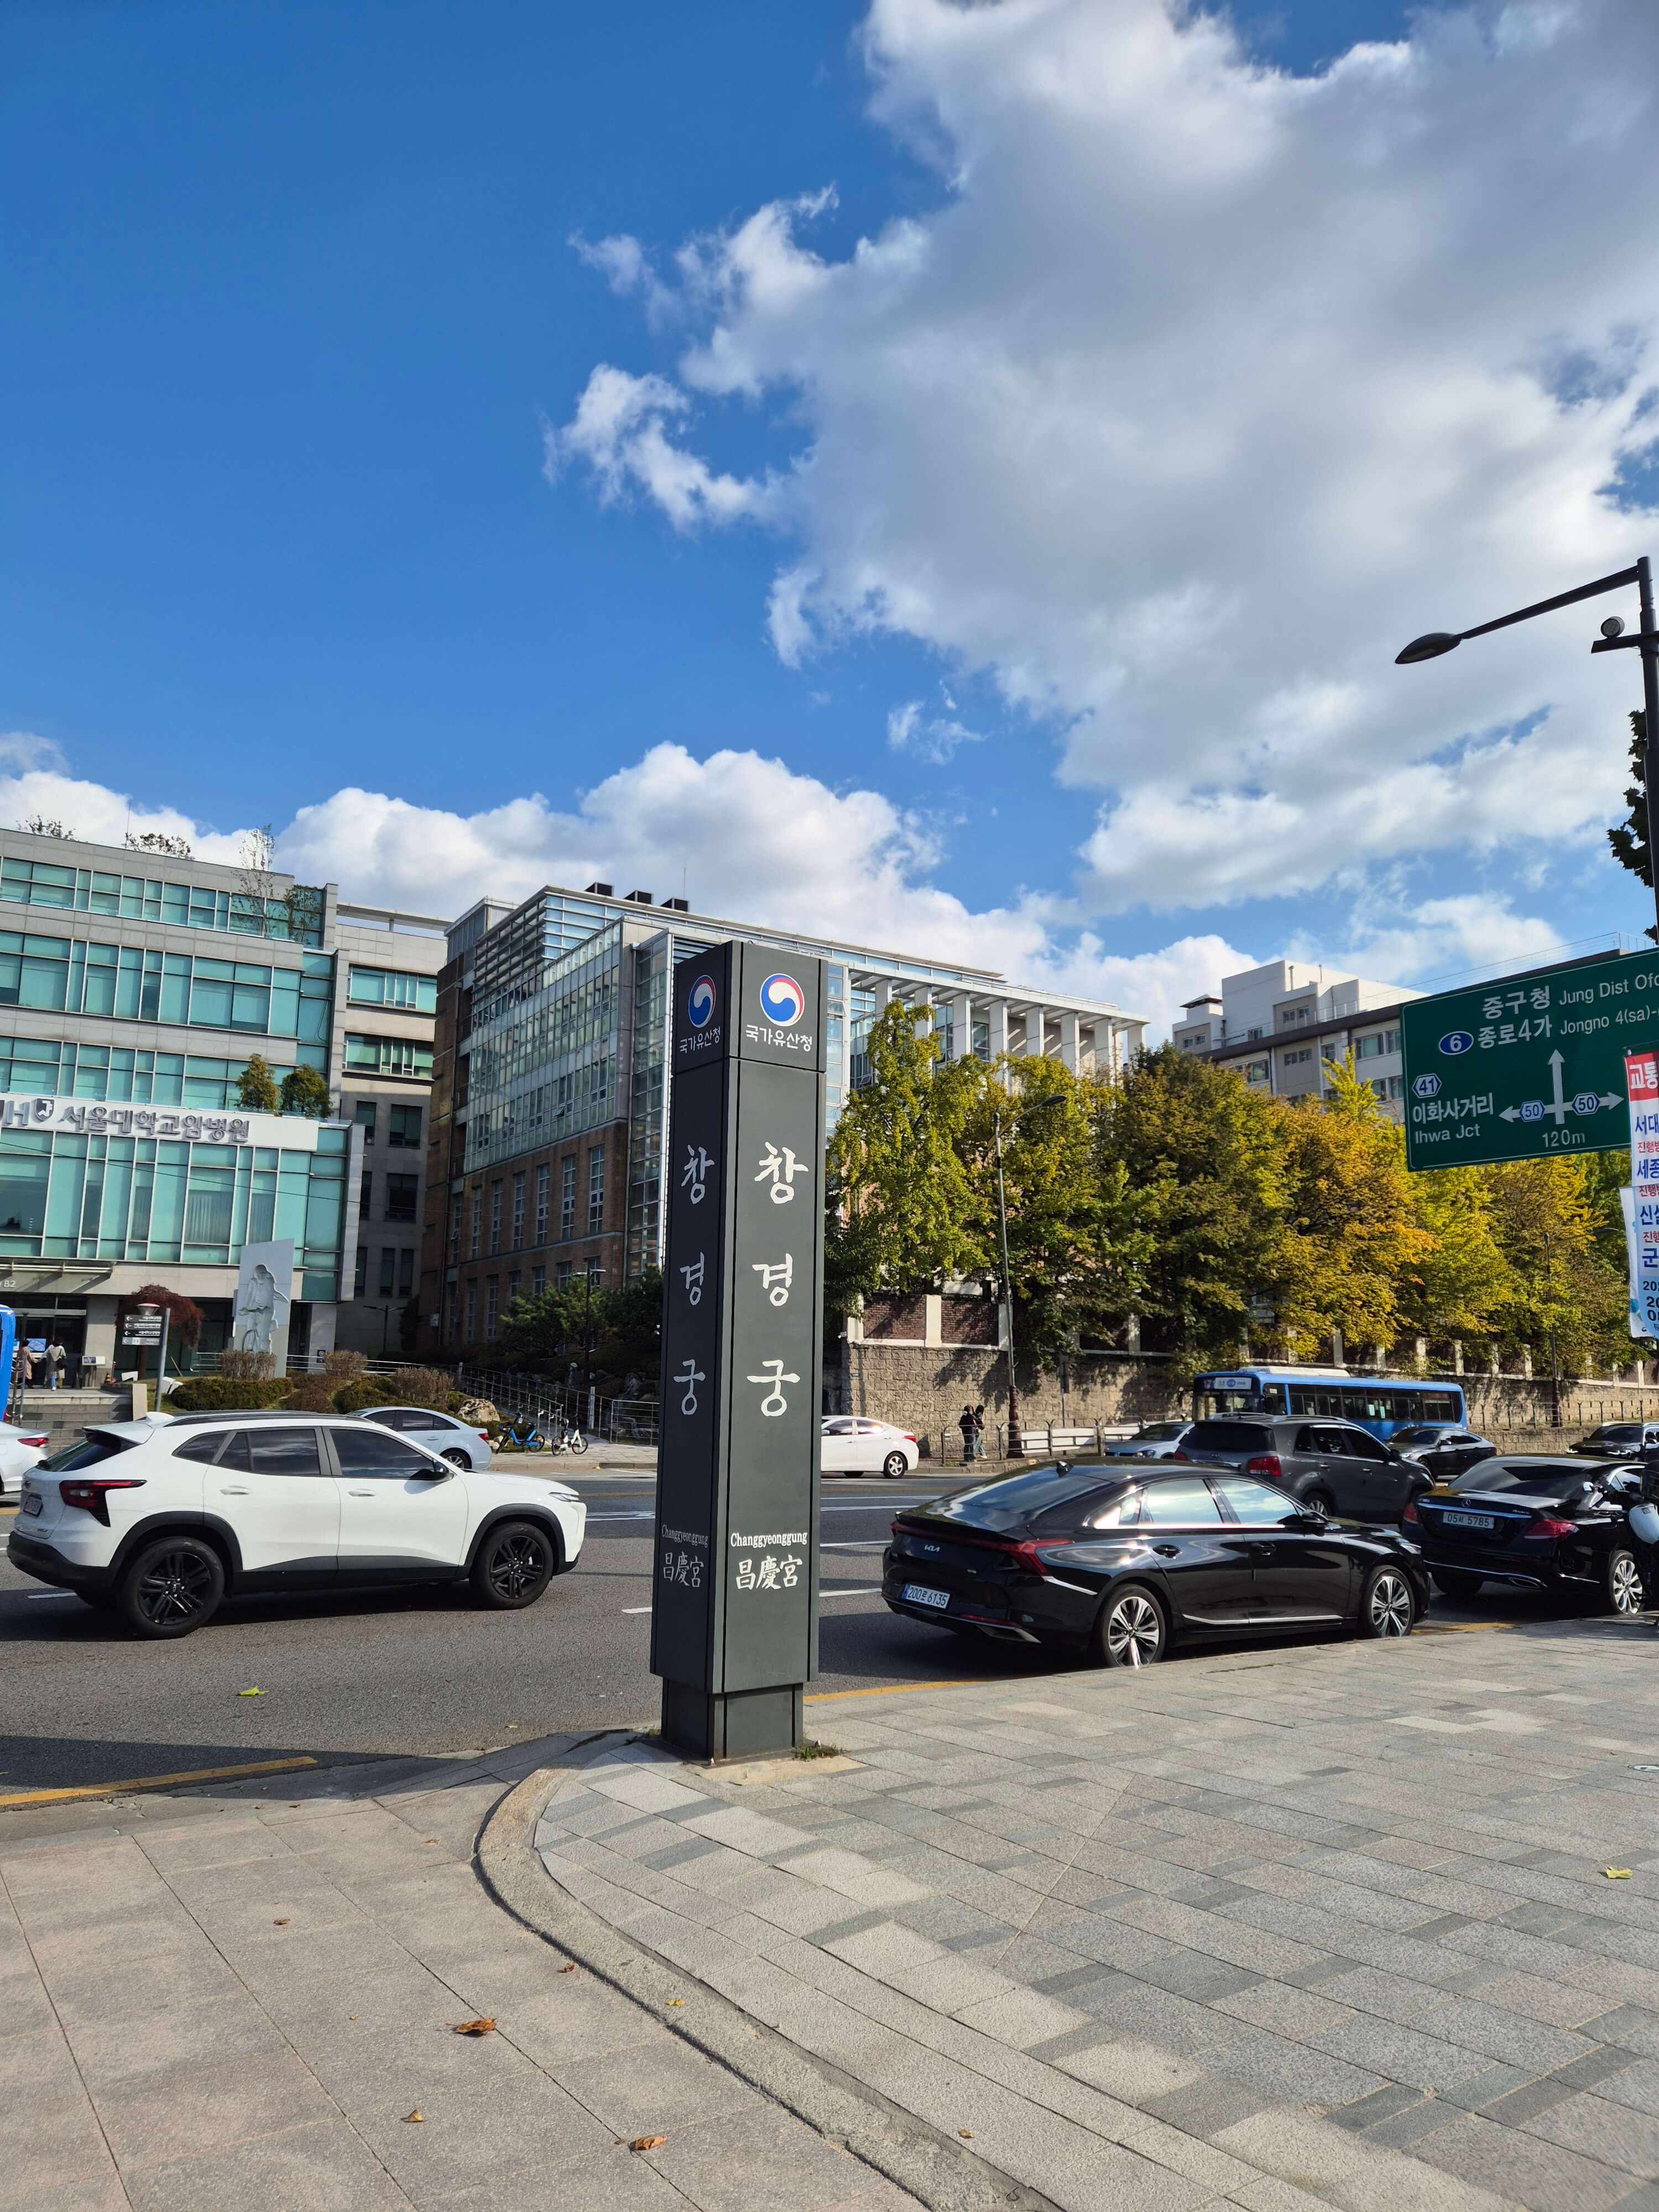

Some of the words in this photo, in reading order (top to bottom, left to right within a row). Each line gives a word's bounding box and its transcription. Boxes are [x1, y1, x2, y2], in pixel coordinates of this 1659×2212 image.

[1483, 985, 1550, 1019] 중구청
[1559, 989, 1594, 1005] Jung
[1599, 979, 1629, 998] Dist
[1478, 1014, 1552, 1048] 종로4가
[1560, 1016, 1609, 1035] Jongno
[1615, 1005, 1659, 1025] 4(sa)-
[679, 1026, 721, 1053] 국가유산청
[745, 1024, 812, 1052] 국가유산청
[1450, 1035, 1462, 1051] 6
[1419, 1078, 1434, 1093] 41
[1413, 1093, 1493, 1124] 이화사거리
[1525, 1104, 1539, 1117] 50
[1579, 1097, 1594, 1111] 50
[58, 1105, 250, 1142] 서울대학교암병원
[1416, 1130, 1451, 1144] Ihwa
[1456, 1124, 1480, 1139] Jct
[1542, 1130, 1585, 1147] 120m
[673, 1145, 714, 1415] 창경궁
[747, 1141, 808, 1417] 창경궁
[1468, 1516, 1490, 1527] 5785
[662, 1525, 708, 1548] Changgyeonggung
[731, 1532, 807, 1548] Changgyeonggung
